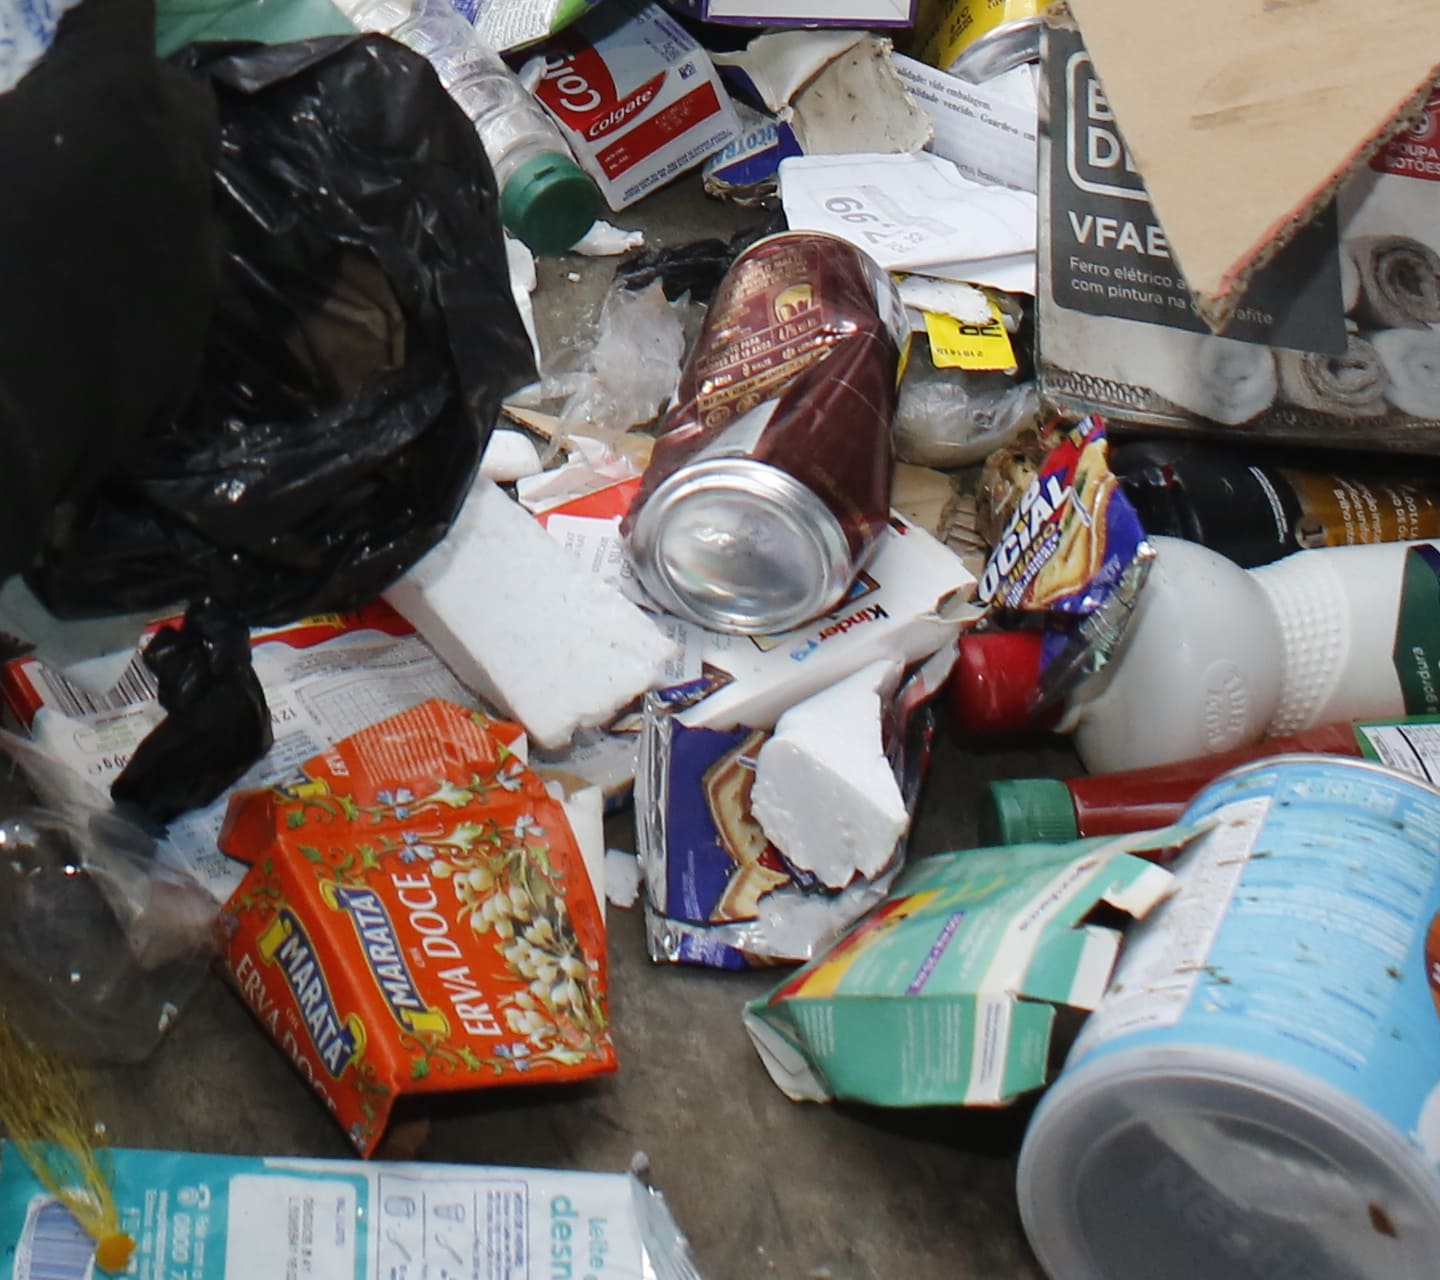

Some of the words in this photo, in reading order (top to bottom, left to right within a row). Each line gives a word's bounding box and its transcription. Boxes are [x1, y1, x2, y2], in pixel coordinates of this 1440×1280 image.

[588, 87, 654, 137] Colgate
[1087, 125, 1138, 176] D
[1070, 256, 1111, 278] Ferro
[1113, 263, 1174, 290] elétrico
[1070, 277, 1105, 297] com
[1107, 285, 1165, 310] pintura
[1167, 295, 1187, 311] na
[819, 603, 890, 643] Kinder
[1411, 645, 1440, 703] gordura
[392, 872, 463, 959] DOCE
[343, 888, 421, 1008] MARATÁ
[235, 954, 278, 1037] ERVA
[278, 933, 354, 1073] MARATÁ
[436, 965, 502, 1036] ERVA
